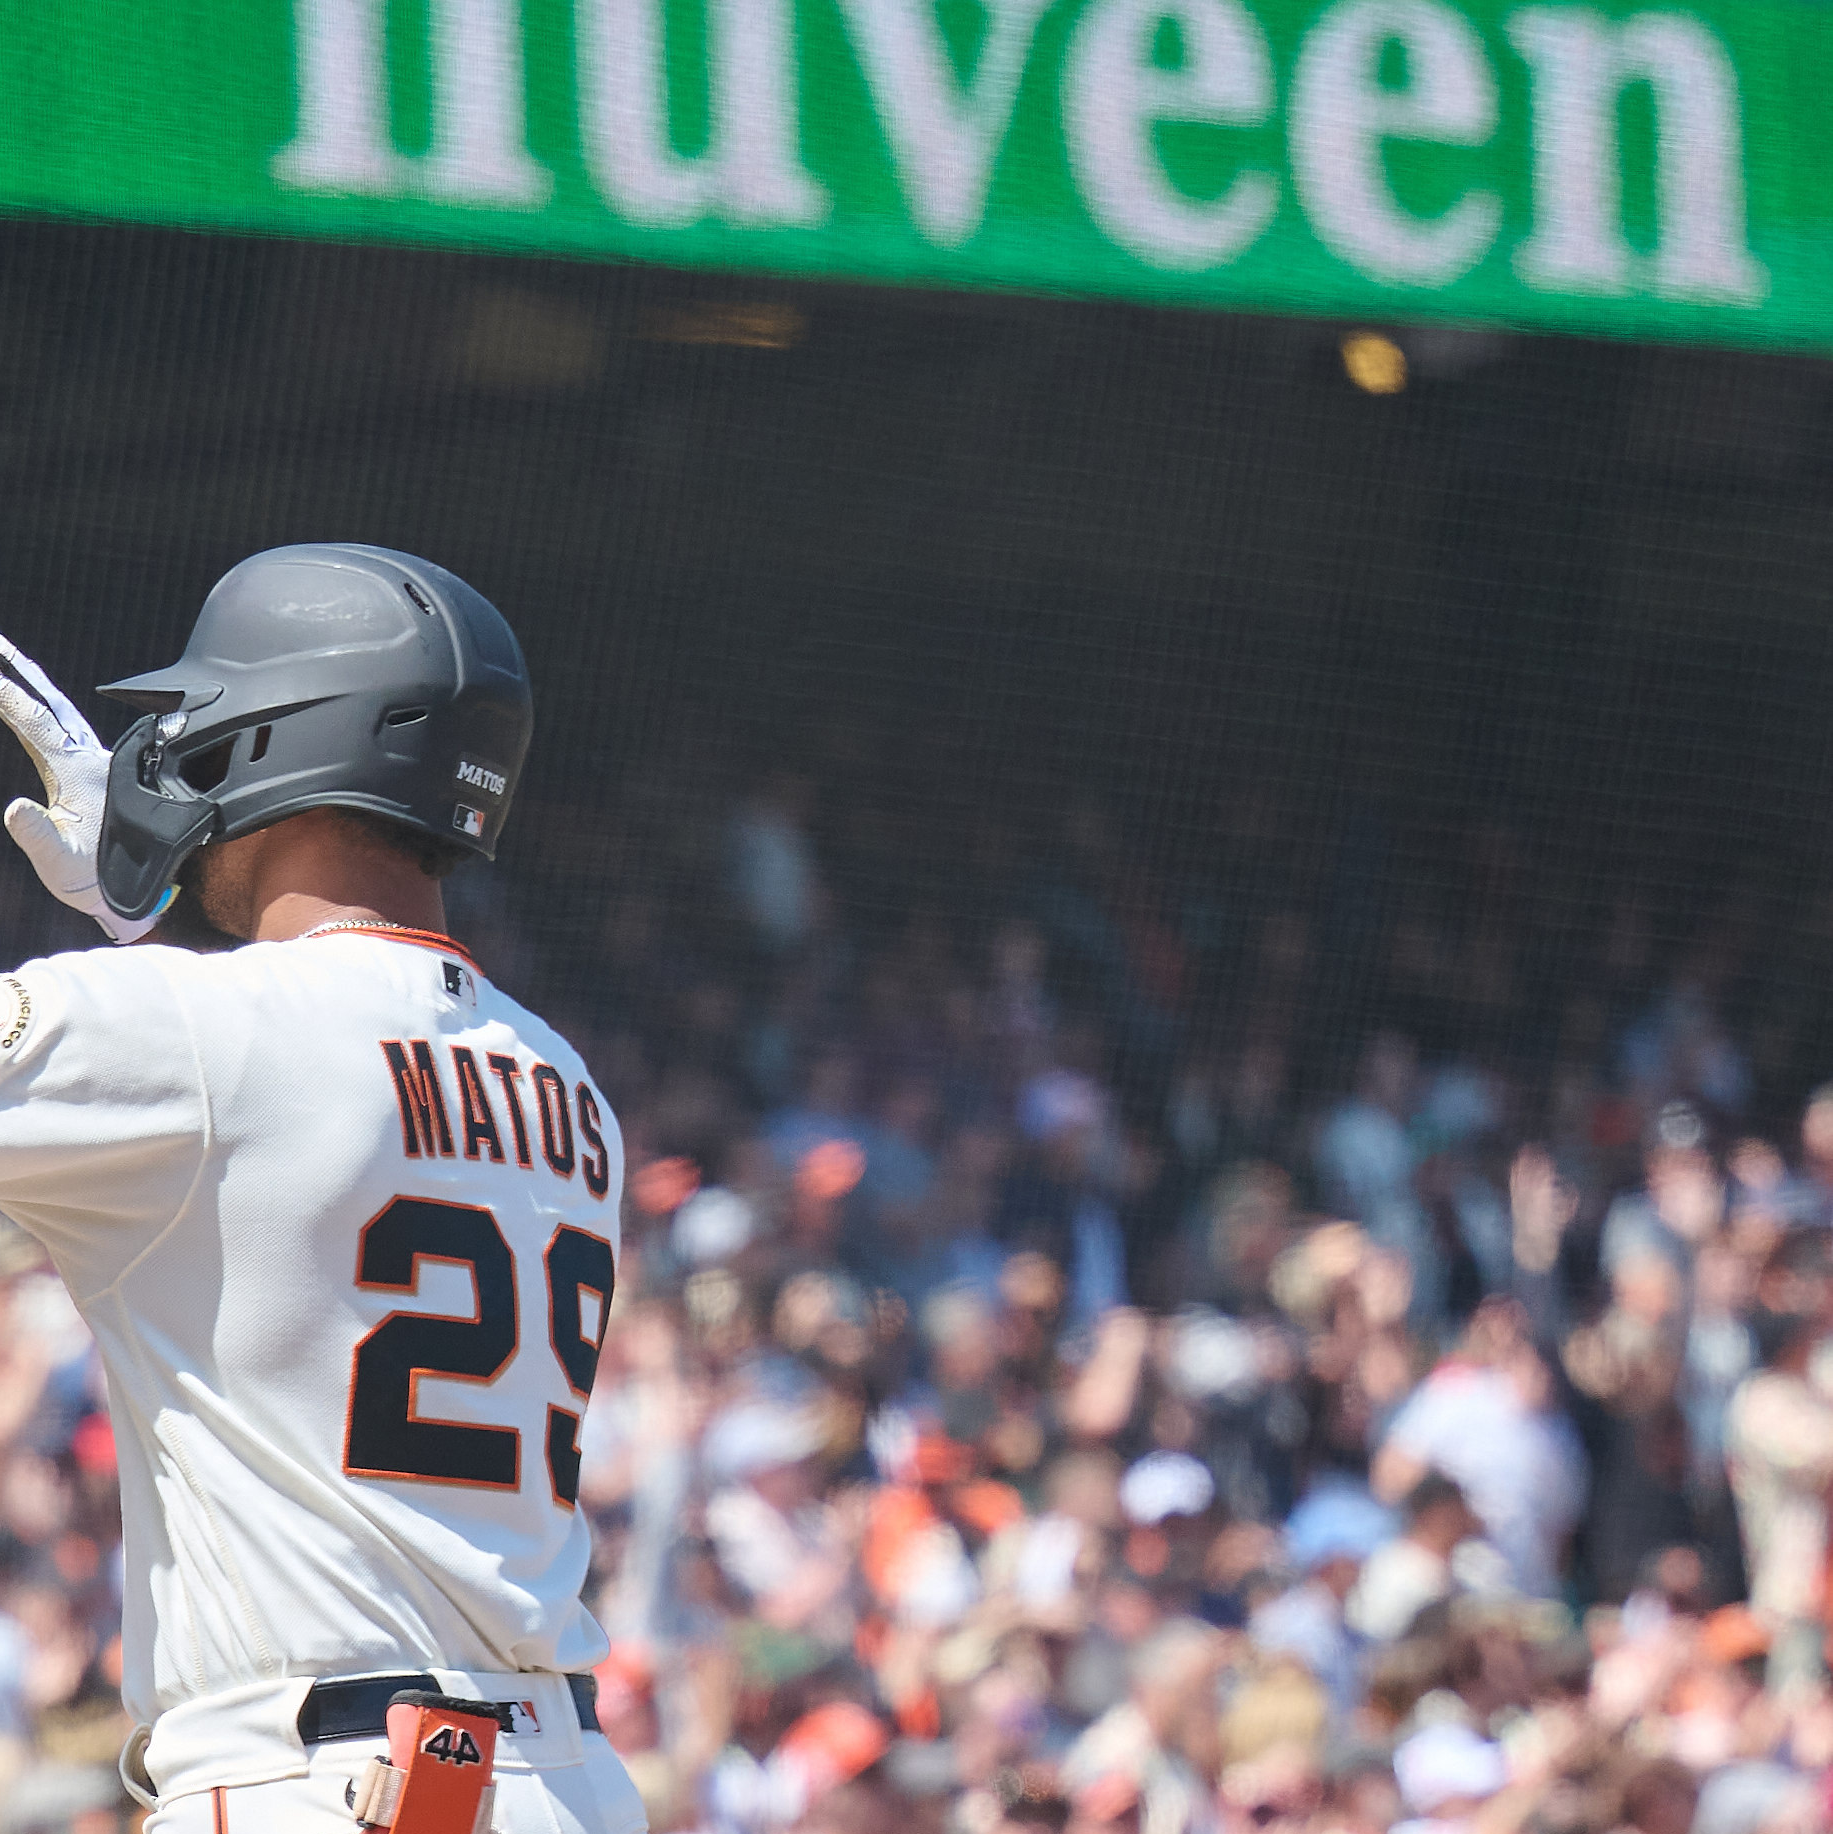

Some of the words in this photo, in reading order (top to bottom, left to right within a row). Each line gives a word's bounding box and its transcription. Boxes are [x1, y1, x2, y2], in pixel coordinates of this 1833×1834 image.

[268, 0, 1768, 308] nuveen
[456, 760, 508, 798] MATOS
[379, 1039, 610, 1201] MATOS
[342, 1193, 615, 1512] 29
[420, 1724, 483, 1767] 44
